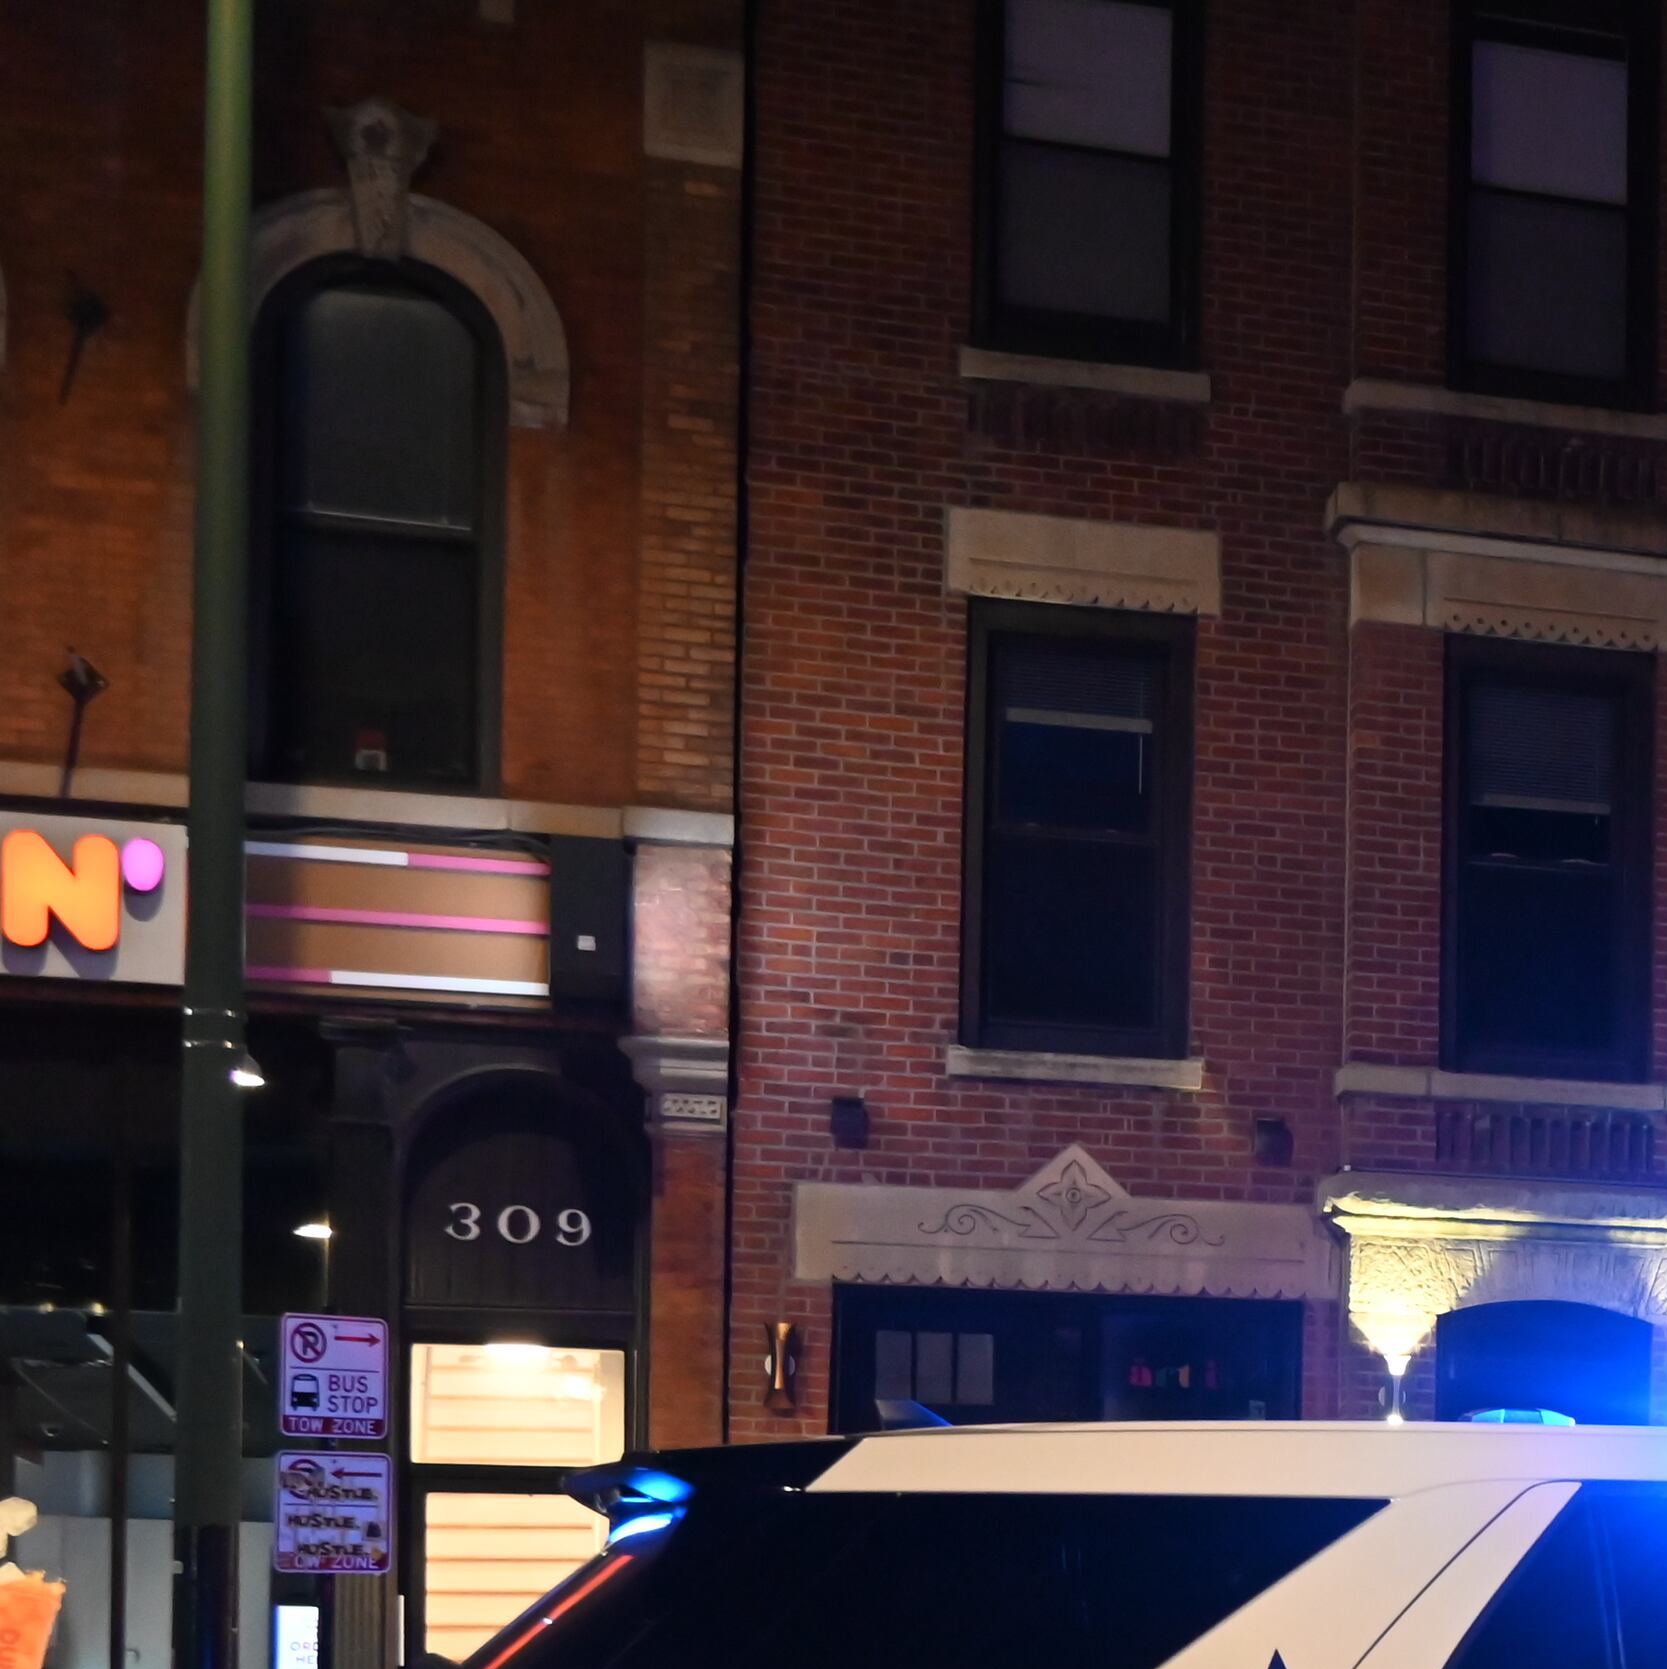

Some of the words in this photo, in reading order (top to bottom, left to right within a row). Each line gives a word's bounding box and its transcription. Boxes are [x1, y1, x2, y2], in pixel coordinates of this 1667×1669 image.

[445, 1203, 592, 1246] 309
[328, 1375, 368, 1393] BUS
[327, 1396, 378, 1413] STOP
[288, 1417, 324, 1433] TOW
[334, 1419, 377, 1435] ZONE
[332, 1556, 378, 1569] ZONE
